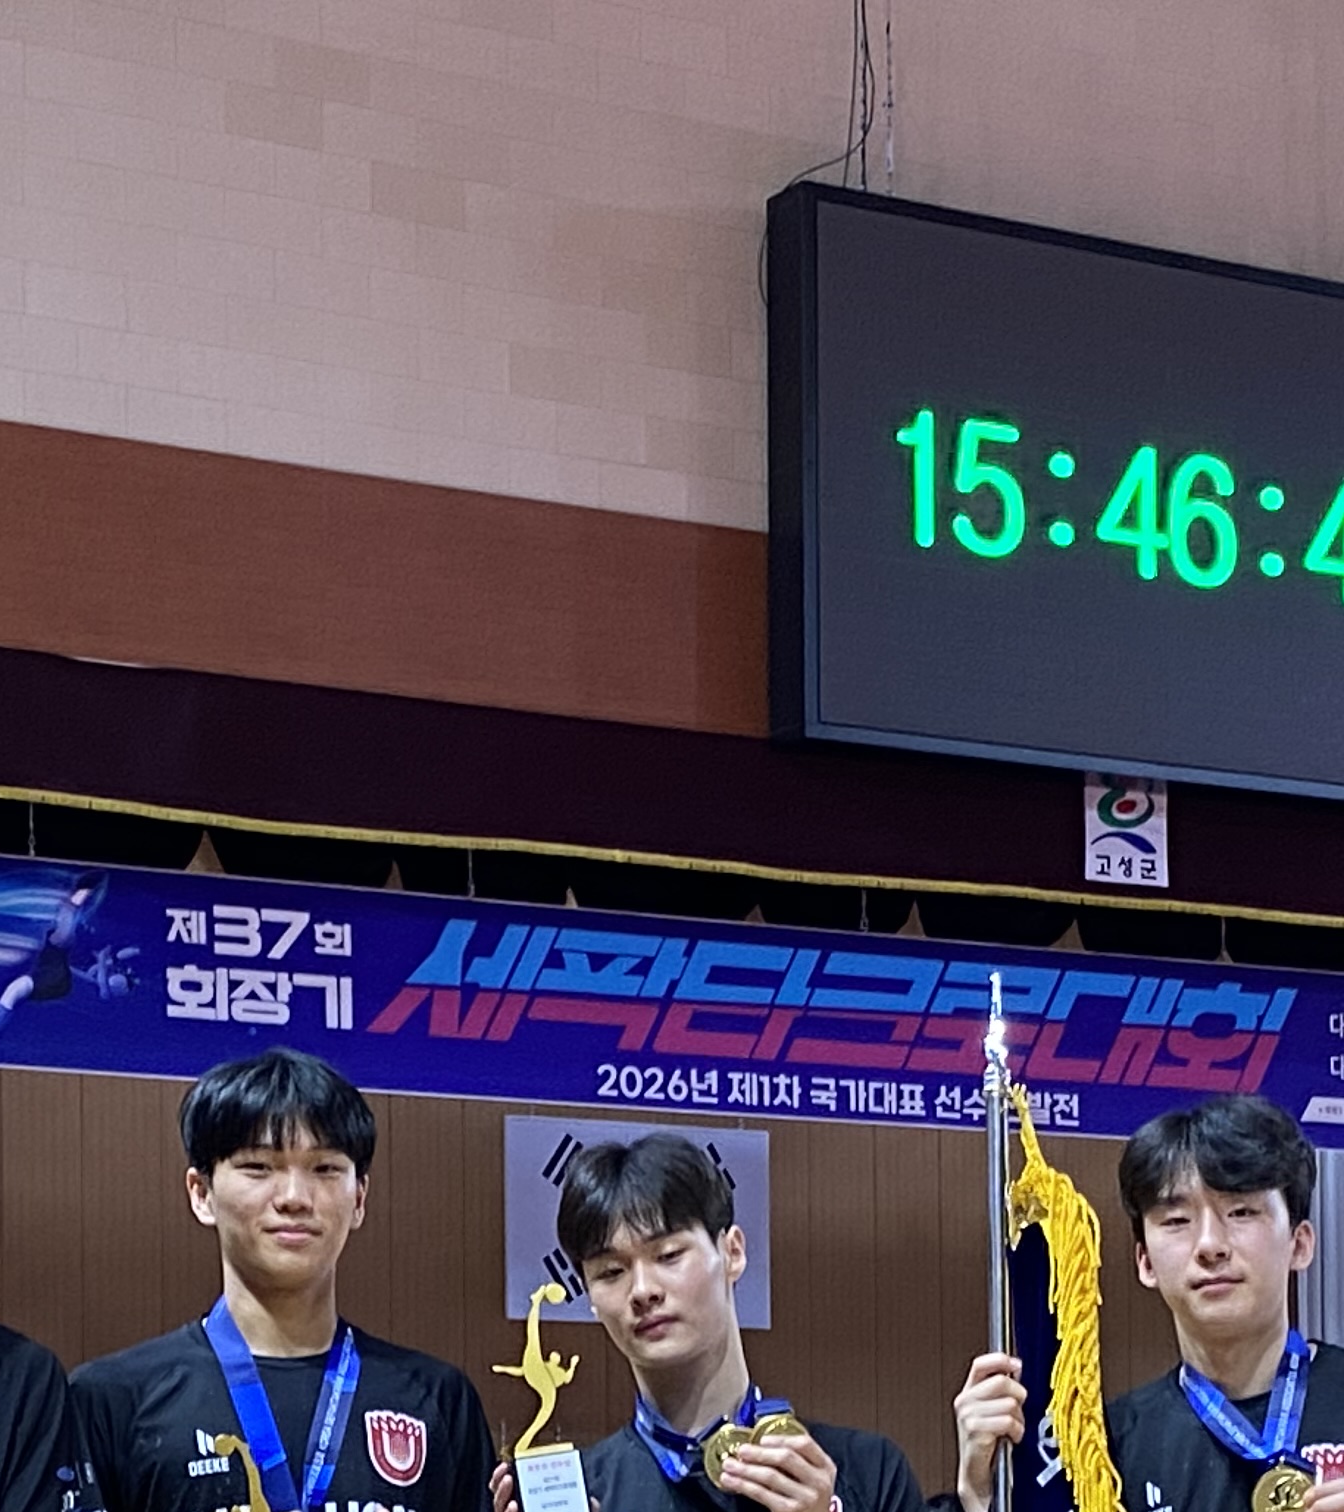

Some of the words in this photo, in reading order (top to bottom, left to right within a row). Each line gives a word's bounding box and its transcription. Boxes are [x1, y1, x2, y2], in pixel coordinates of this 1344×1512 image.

[1095, 854, 1158, 881] 고성군
[166, 904, 353, 959] 제37회
[166, 965, 354, 1031] 회장기
[596, 1063, 720, 1106] 2026년
[726, 1072, 801, 1110] 제1차
[809, 1079, 927, 1119] 국가대표
